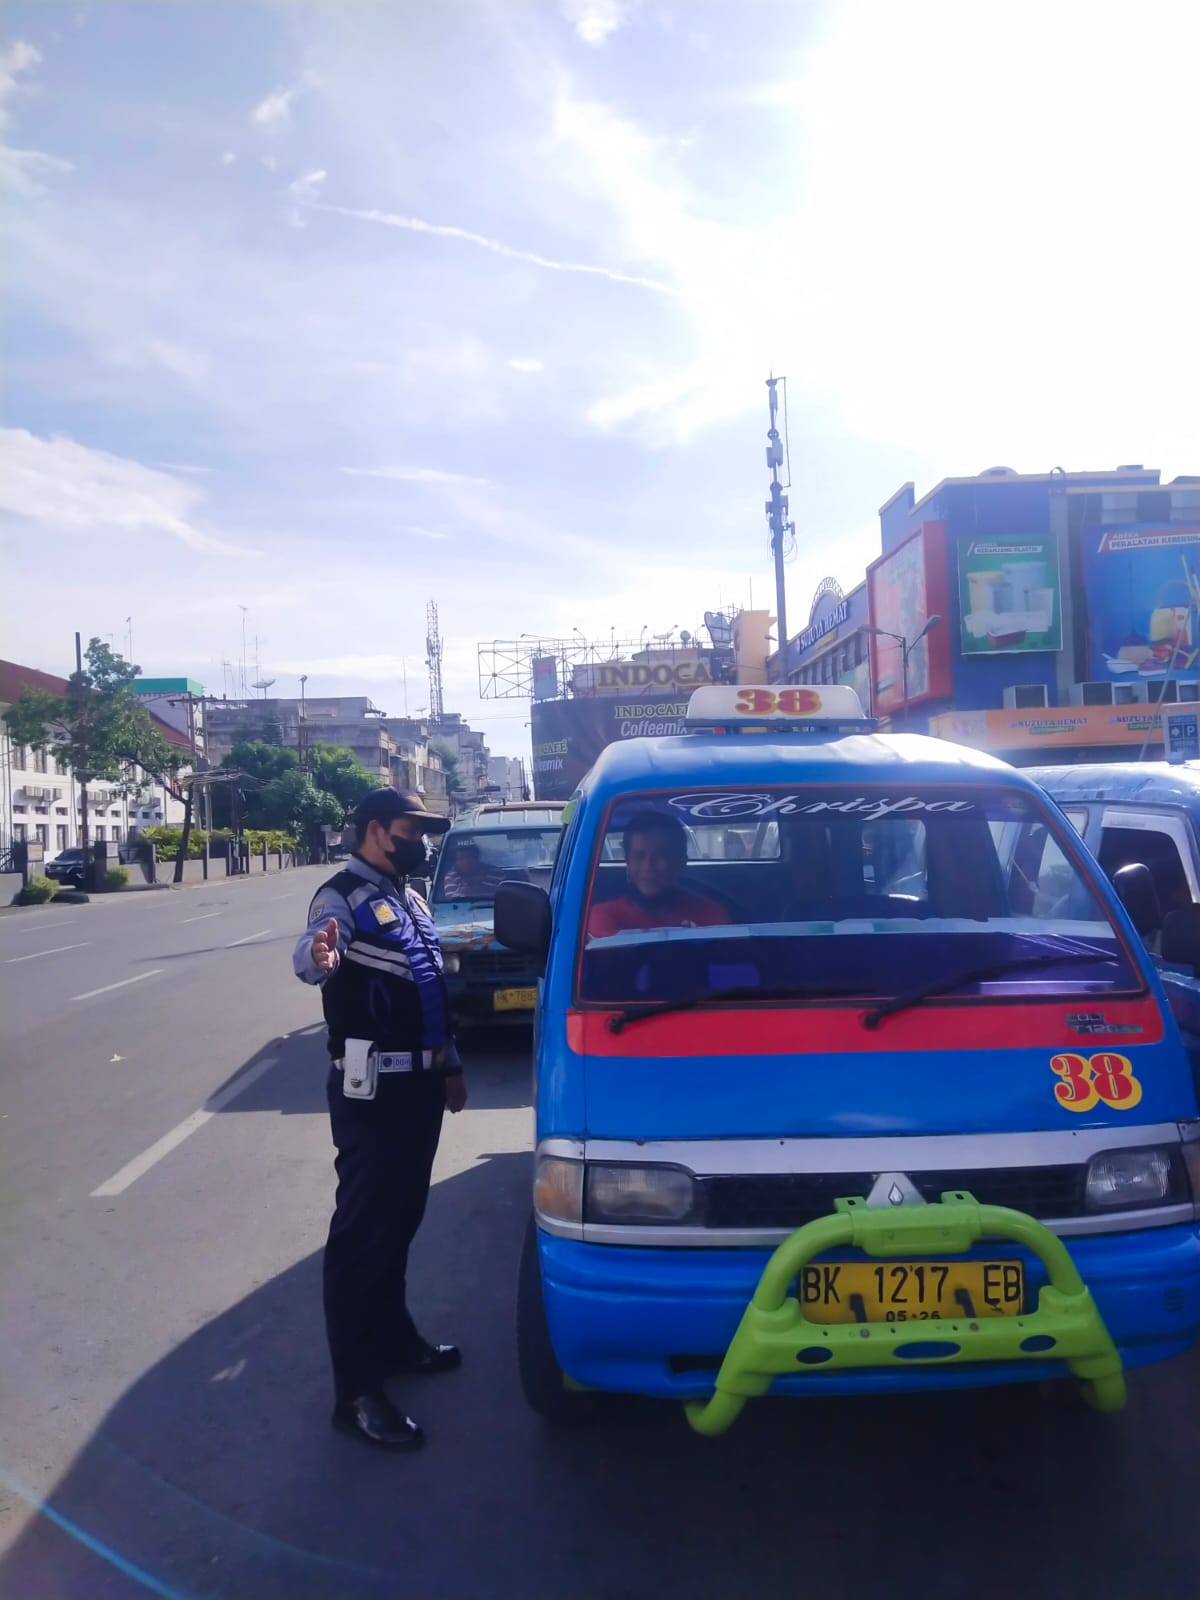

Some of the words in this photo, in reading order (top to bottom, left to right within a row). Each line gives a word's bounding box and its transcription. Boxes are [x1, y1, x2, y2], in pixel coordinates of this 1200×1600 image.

[615, 703, 688, 718] INDOCAF
[735, 688, 822, 716] 38
[668, 792, 976, 821] Chrispa
[1050, 1052, 1142, 1112] 38
[802, 1265, 841, 1304] BK
[874, 1265, 950, 1304] 1217
